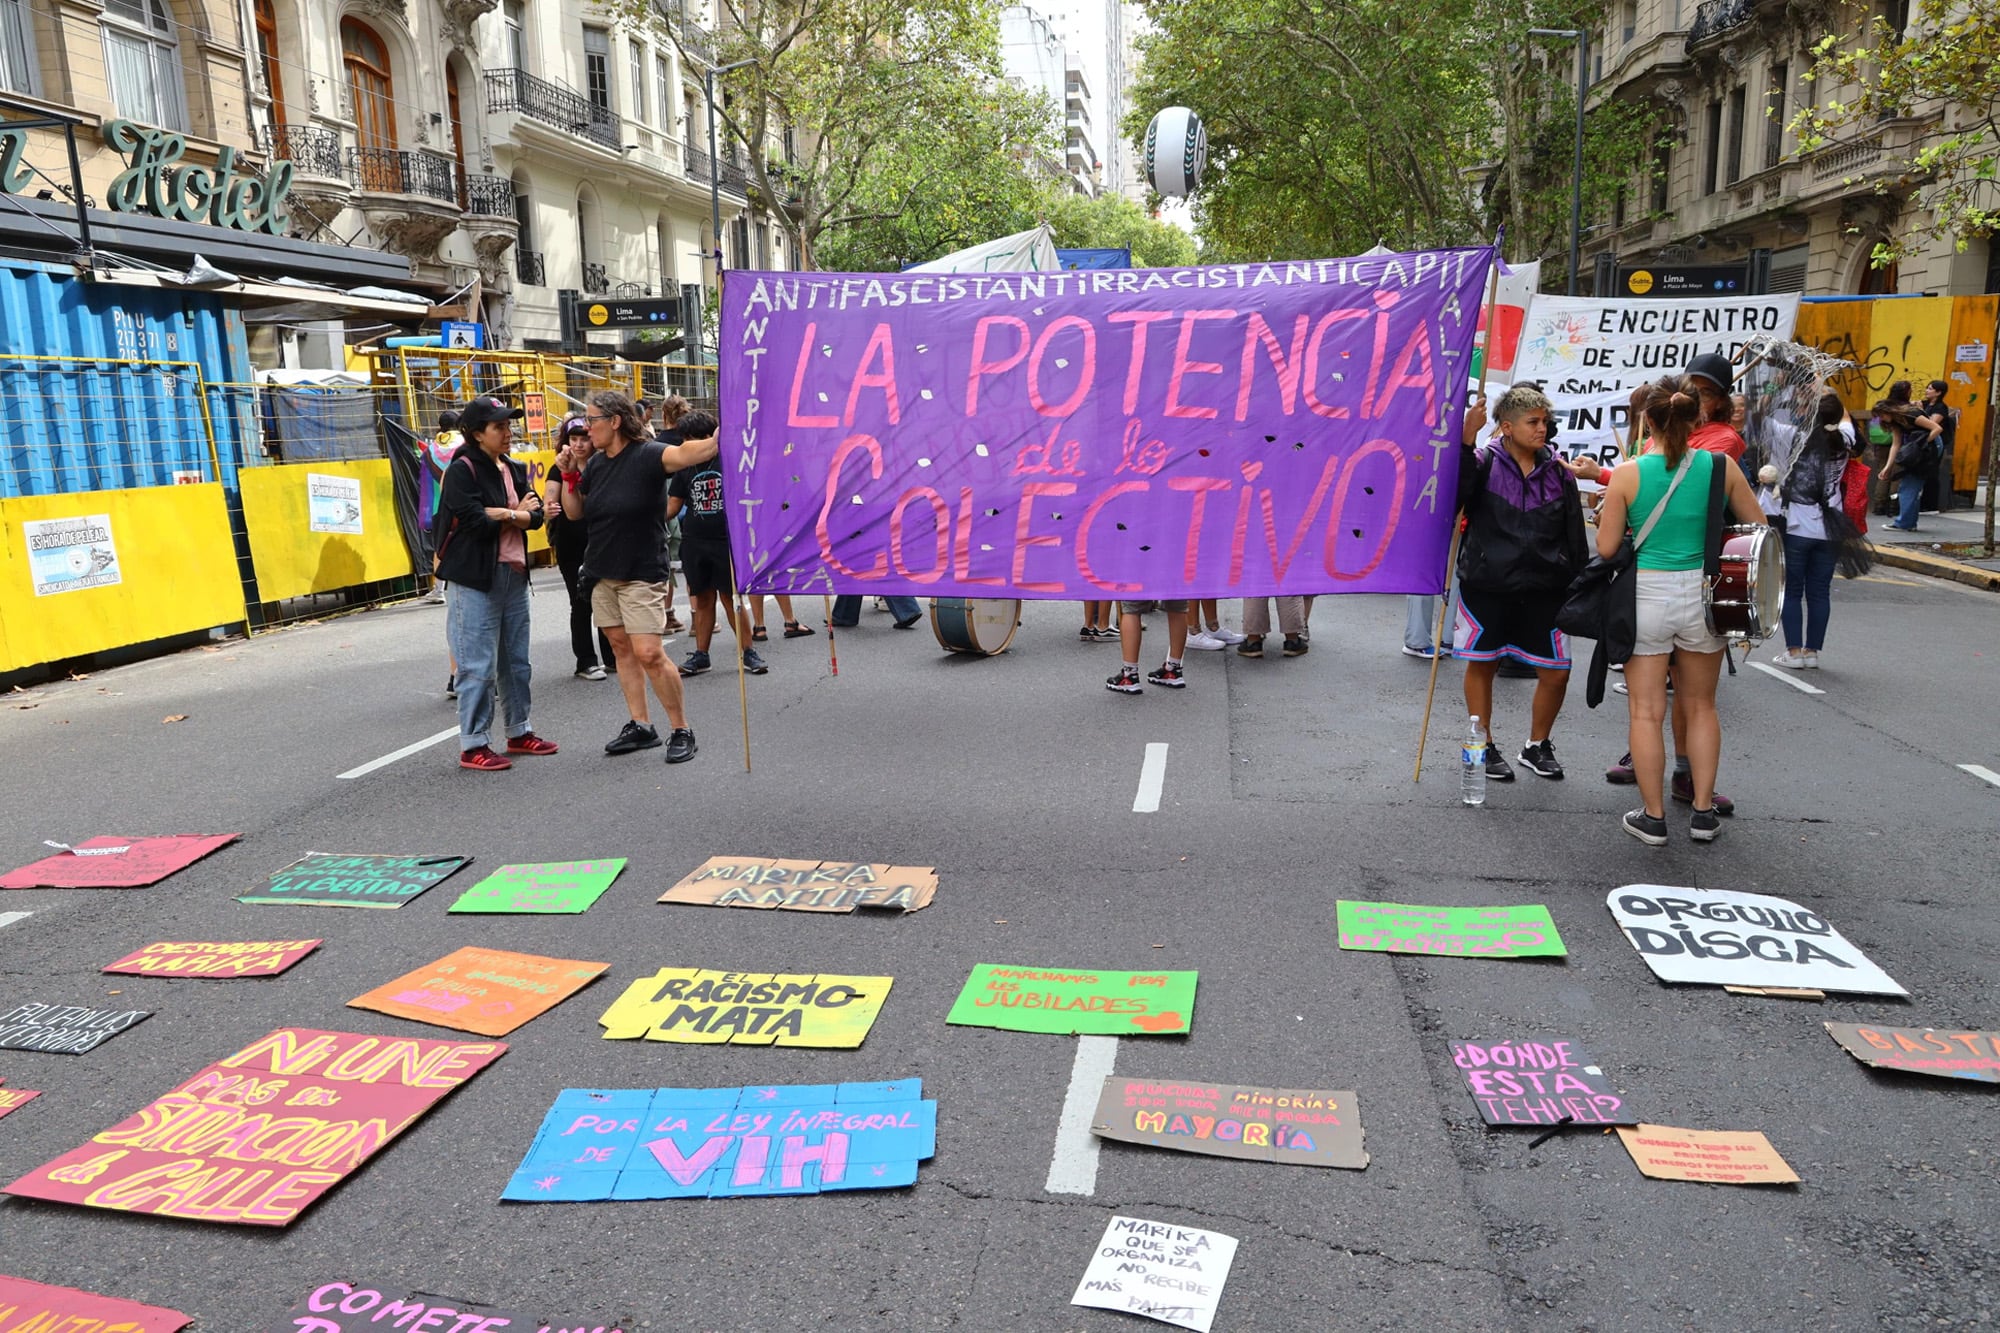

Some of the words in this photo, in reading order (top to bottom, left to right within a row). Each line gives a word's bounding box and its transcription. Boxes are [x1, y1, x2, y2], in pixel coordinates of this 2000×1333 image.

[103, 118, 293, 235] Hotel
[1663, 275, 1684, 283] Lima
[450, 322, 475, 330] Turismo
[1598, 306, 1779, 334] ENCUENTRO
[787, 322, 899, 428] LA
[966, 290, 1437, 427] POTENCIA
[1583, 348, 1615, 368] DE
[1009, 424, 1087, 477] de
[694, 478, 722, 491] STOP
[696, 489, 722, 501] PLAY
[693, 500, 724, 510] PAUSE
[816, 434, 1407, 593] COLECTIVO
[30, 535, 42, 551] ES
[42, 531, 65, 549] HORA
[65, 530, 76, 546] DE
[269, 877, 424, 896] LIBERTAD
[697, 865, 877, 886] MARIKA
[715, 885, 915, 908] ANTIFA
[112, 953, 286, 974] MARIKA
[722, 973, 749, 983] EL
[651, 979, 857, 1008] RACISMO
[660, 1005, 803, 1037] MATA
[225, 1031, 338, 1076] NI
[326, 1038, 497, 1088] UNE
[1124, 1082, 1222, 1100] MUCHAS
[1468, 1067, 1596, 1097] ESTÁ
[1124, 1096, 1167, 1108] SON
[1176, 1096, 1218, 1111] UNA
[561, 1114, 639, 1137] POR
[654, 1116, 689, 1133] LA
[704, 1111, 771, 1139] LEY
[779, 1109, 921, 1131] INTEGRAL
[1134, 1109, 1318, 1151] MAYORÍA
[574, 1146, 617, 1163] DE
[641, 1132, 852, 1188] VIH
[84, 1158, 342, 1222] CALLE
[1114, 1219, 1211, 1251] MARIKA
[1126, 1236, 1164, 1252] QUE
[1173, 1245, 1199, 1257] SE
[1101, 1247, 1203, 1272] ORGANIZA
[1117, 1262, 1147, 1274] NO
[1144, 1273, 1212, 1296] RECIBE
